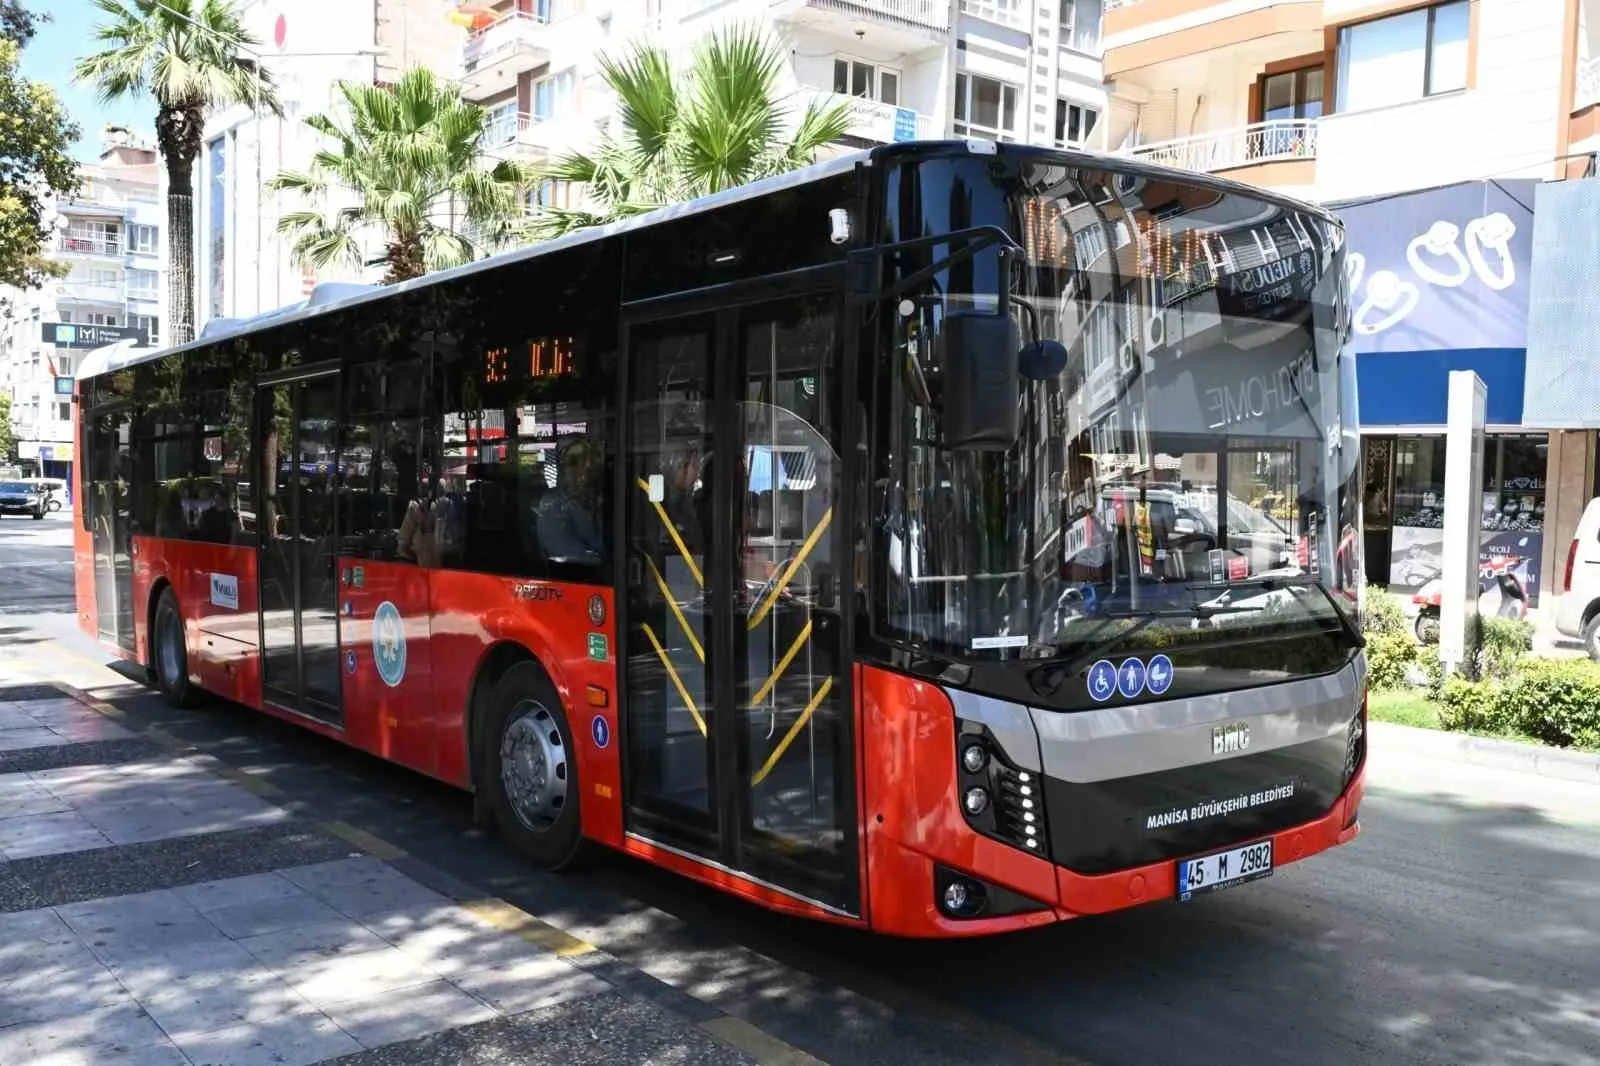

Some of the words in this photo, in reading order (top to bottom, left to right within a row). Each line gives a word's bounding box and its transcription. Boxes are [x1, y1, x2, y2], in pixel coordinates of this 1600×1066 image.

[1147, 807, 1188, 829] MANİSA
[1190, 793, 1248, 816] BÜYÜKŞEHİR
[1250, 781, 1294, 806] BELEDİYESİ
[1188, 861, 1204, 889] 45
[1219, 855, 1228, 879] M
[1240, 845, 1270, 873] 2982
